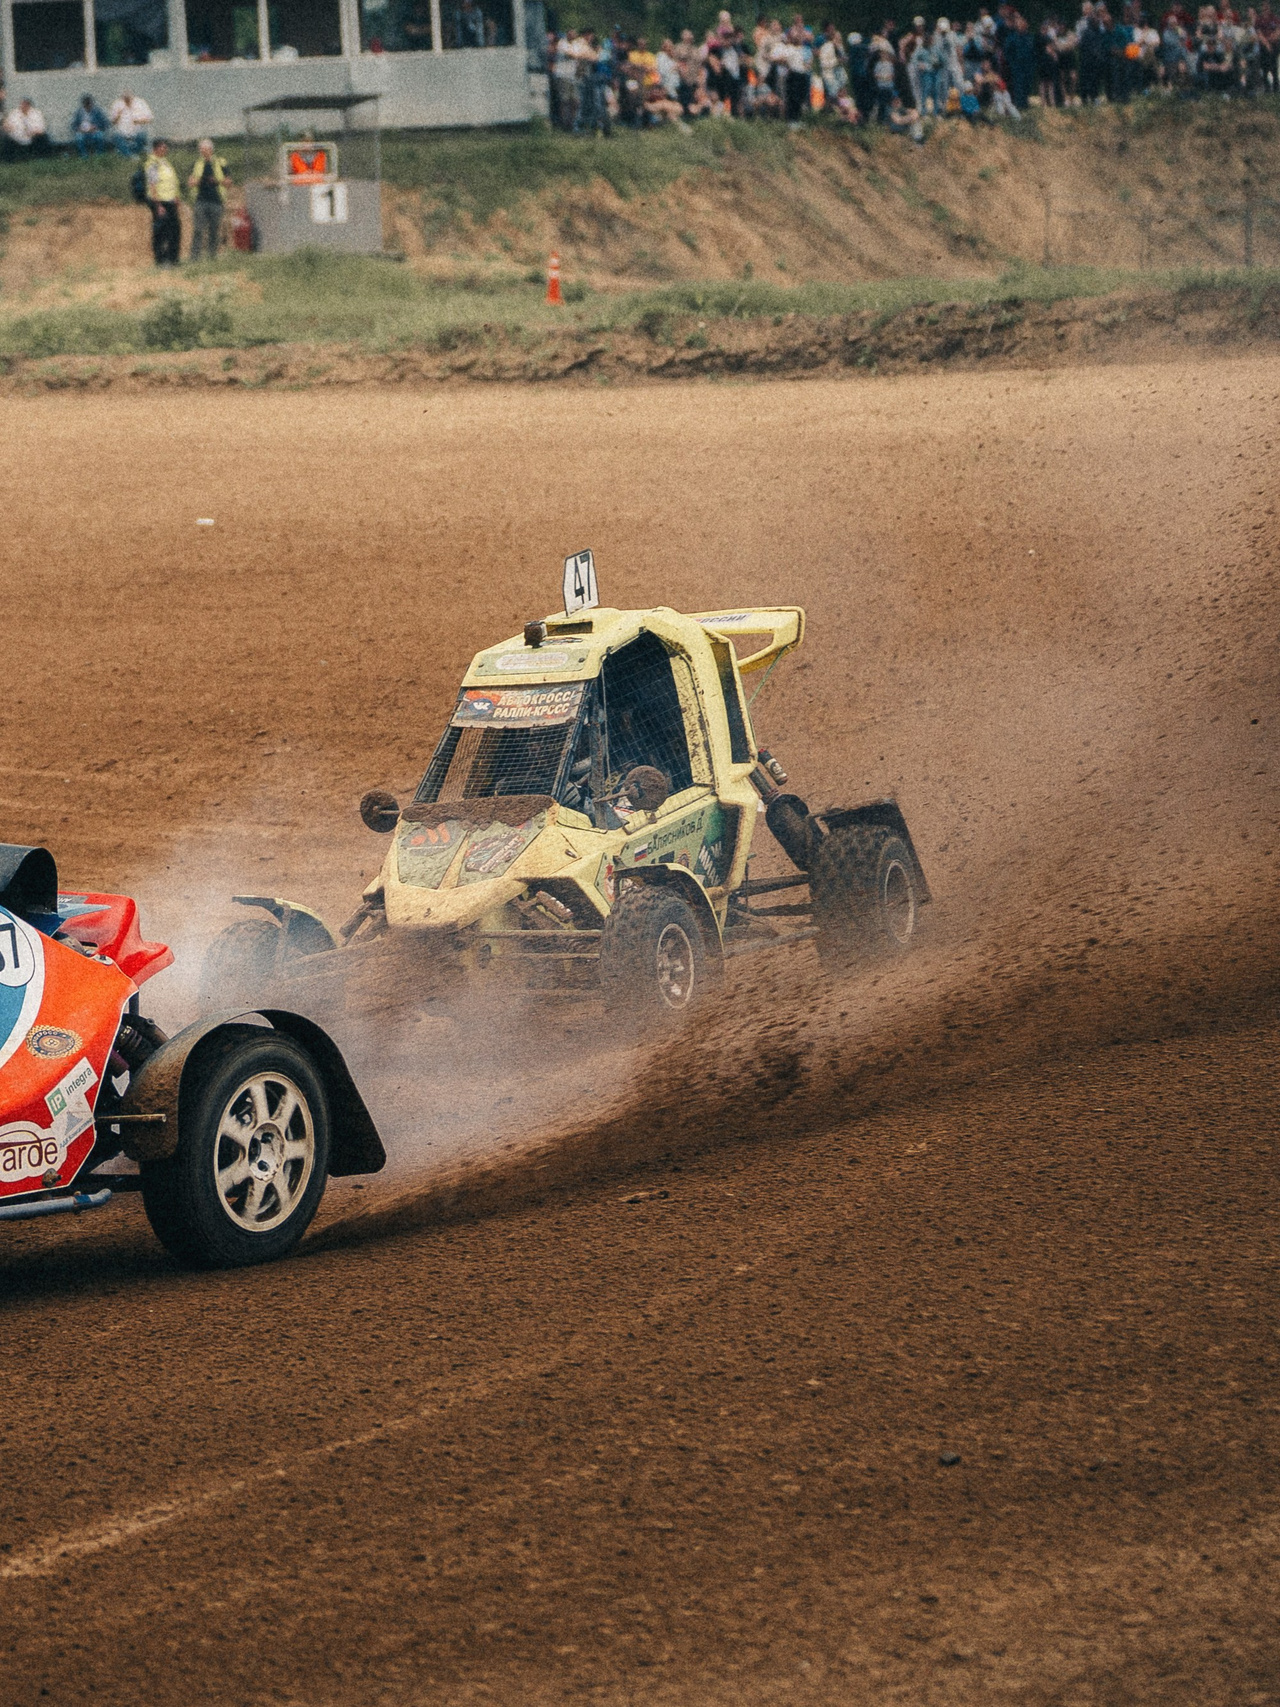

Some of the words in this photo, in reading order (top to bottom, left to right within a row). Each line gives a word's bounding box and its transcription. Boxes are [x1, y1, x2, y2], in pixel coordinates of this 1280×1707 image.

[321, 189, 335, 217] 1
[574, 552, 592, 605] 47
[65, 1067, 93, 1096] integra
